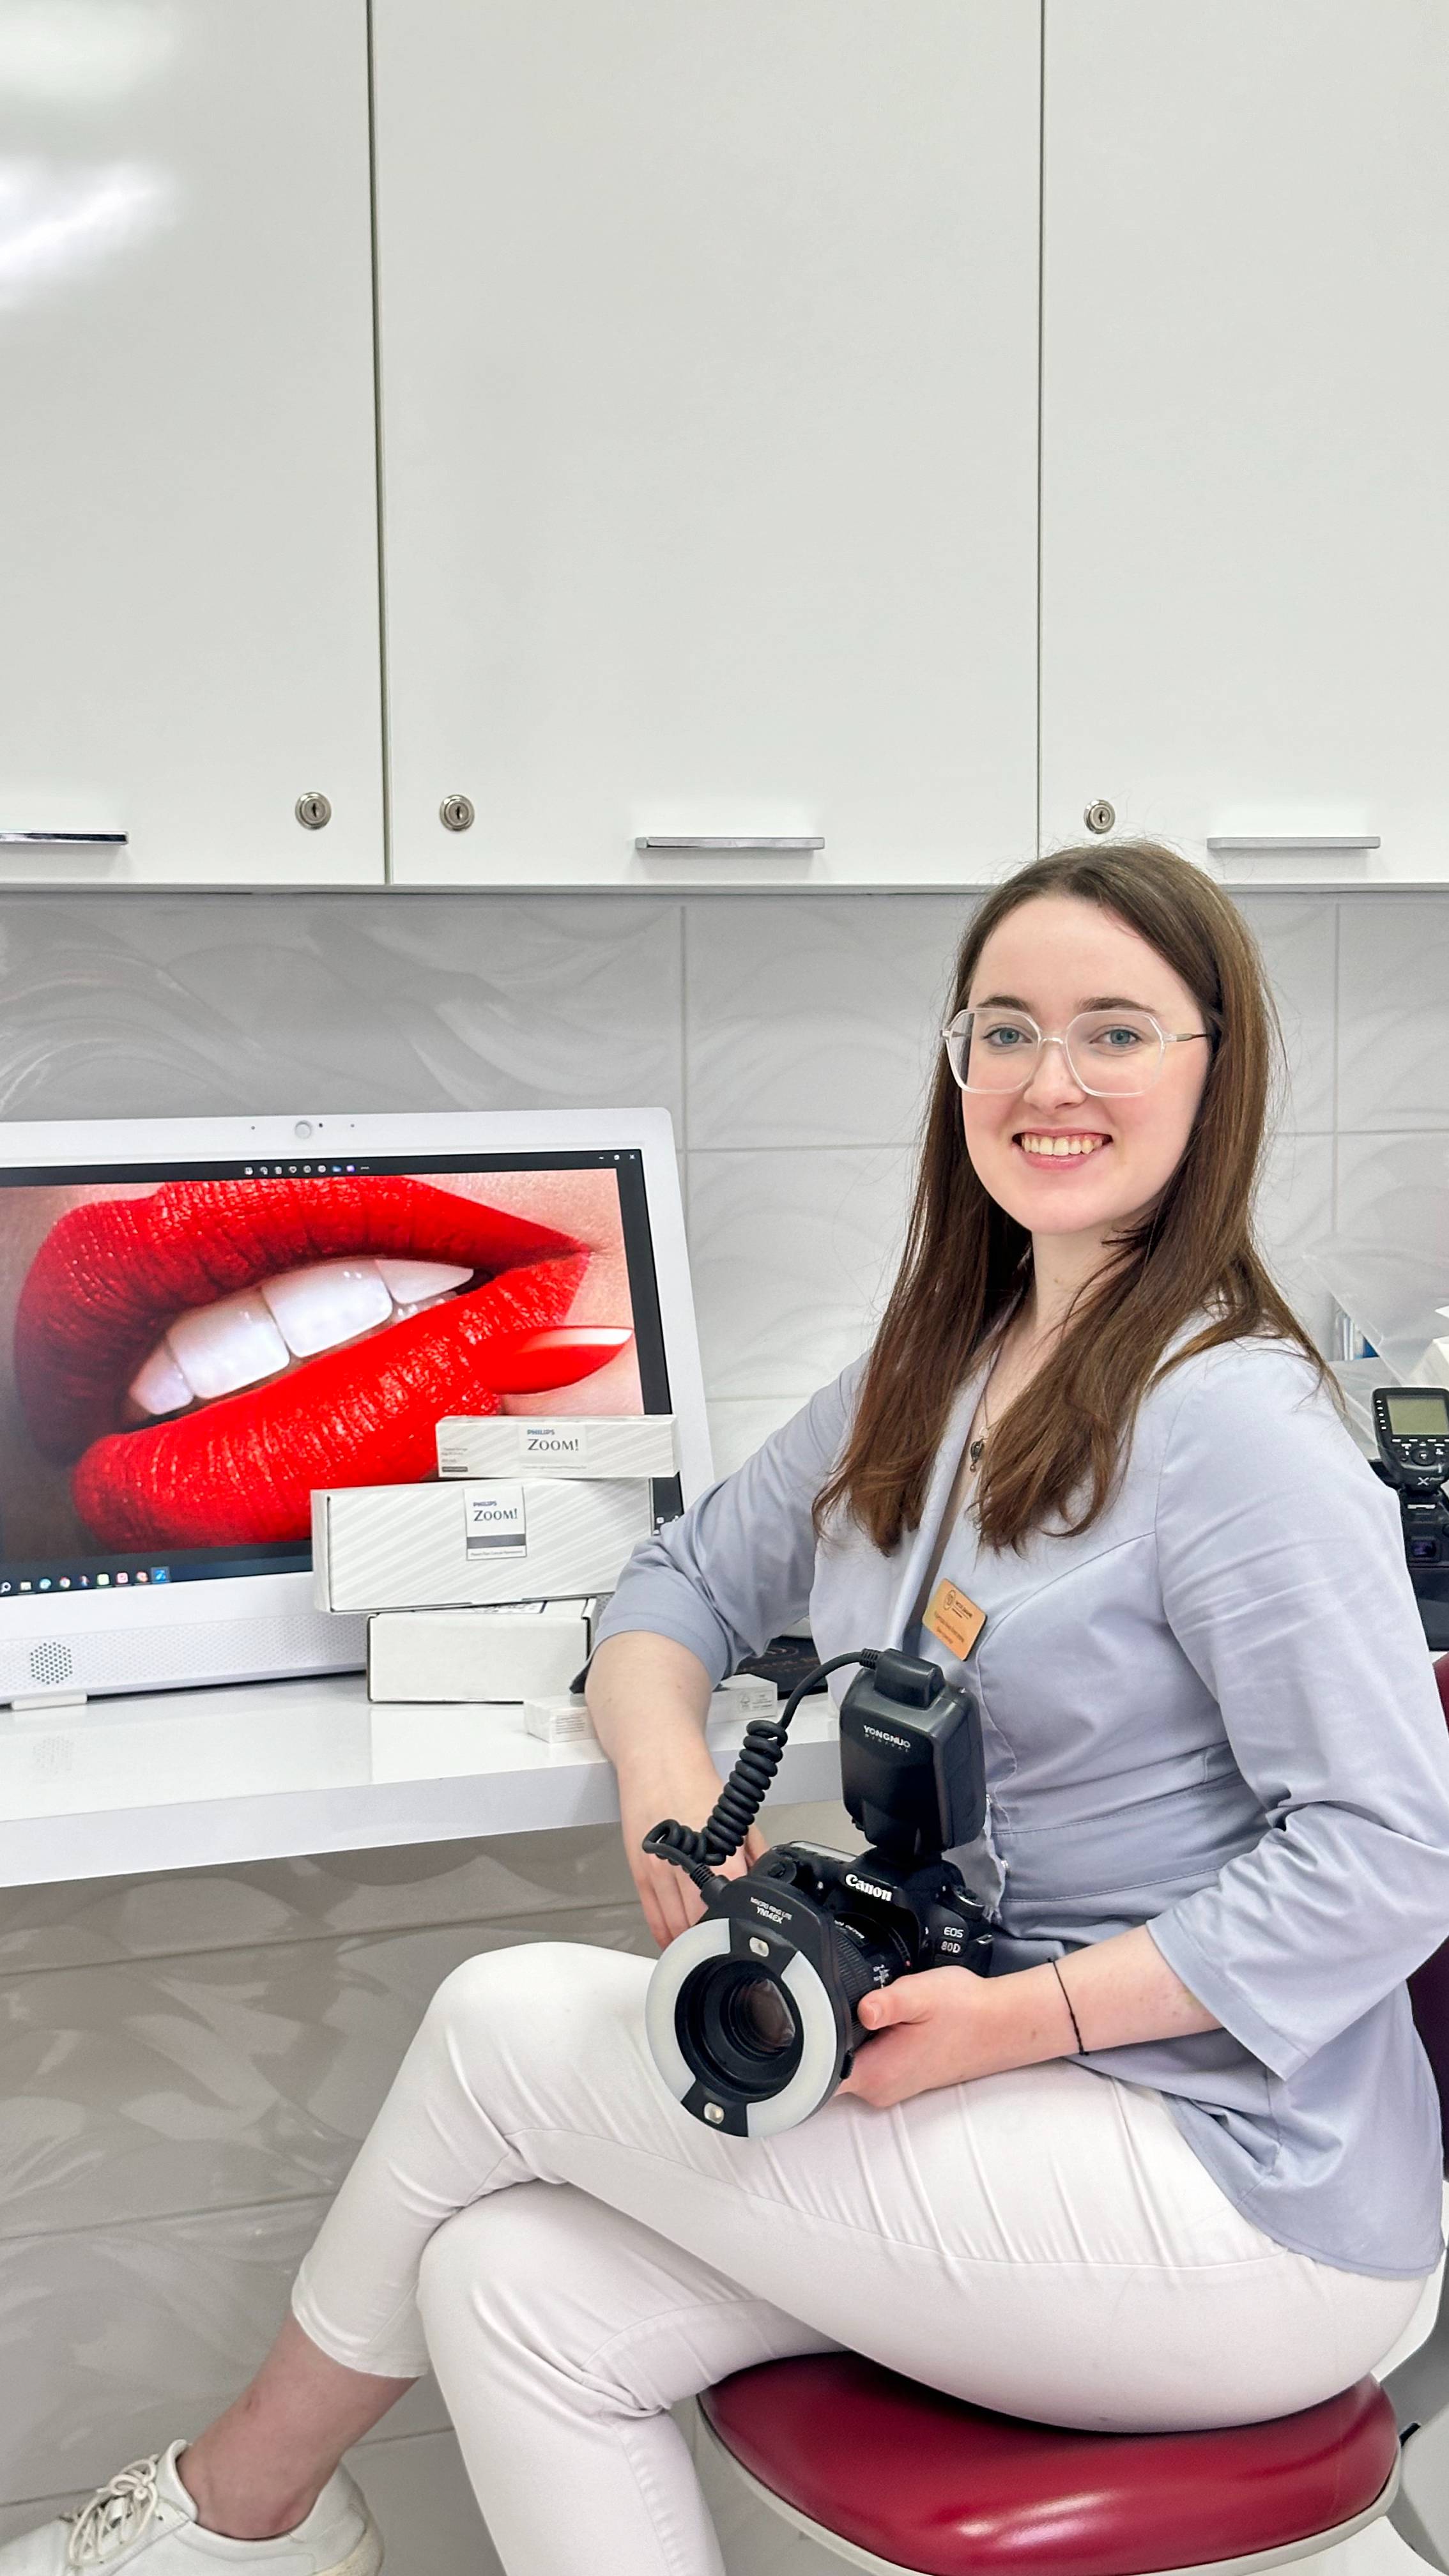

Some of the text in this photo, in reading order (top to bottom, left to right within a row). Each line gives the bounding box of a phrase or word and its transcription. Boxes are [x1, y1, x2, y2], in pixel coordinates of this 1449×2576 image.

[528, 1438, 579, 1452] ZOOM!
[473, 1508, 518, 1521] ZOOM!
[863, 1725, 911, 1748] YONGNUO
[845, 1873, 893, 1901] Canon
[944, 1926, 964, 1938] EOS
[940, 1941, 961, 1953] 80D
